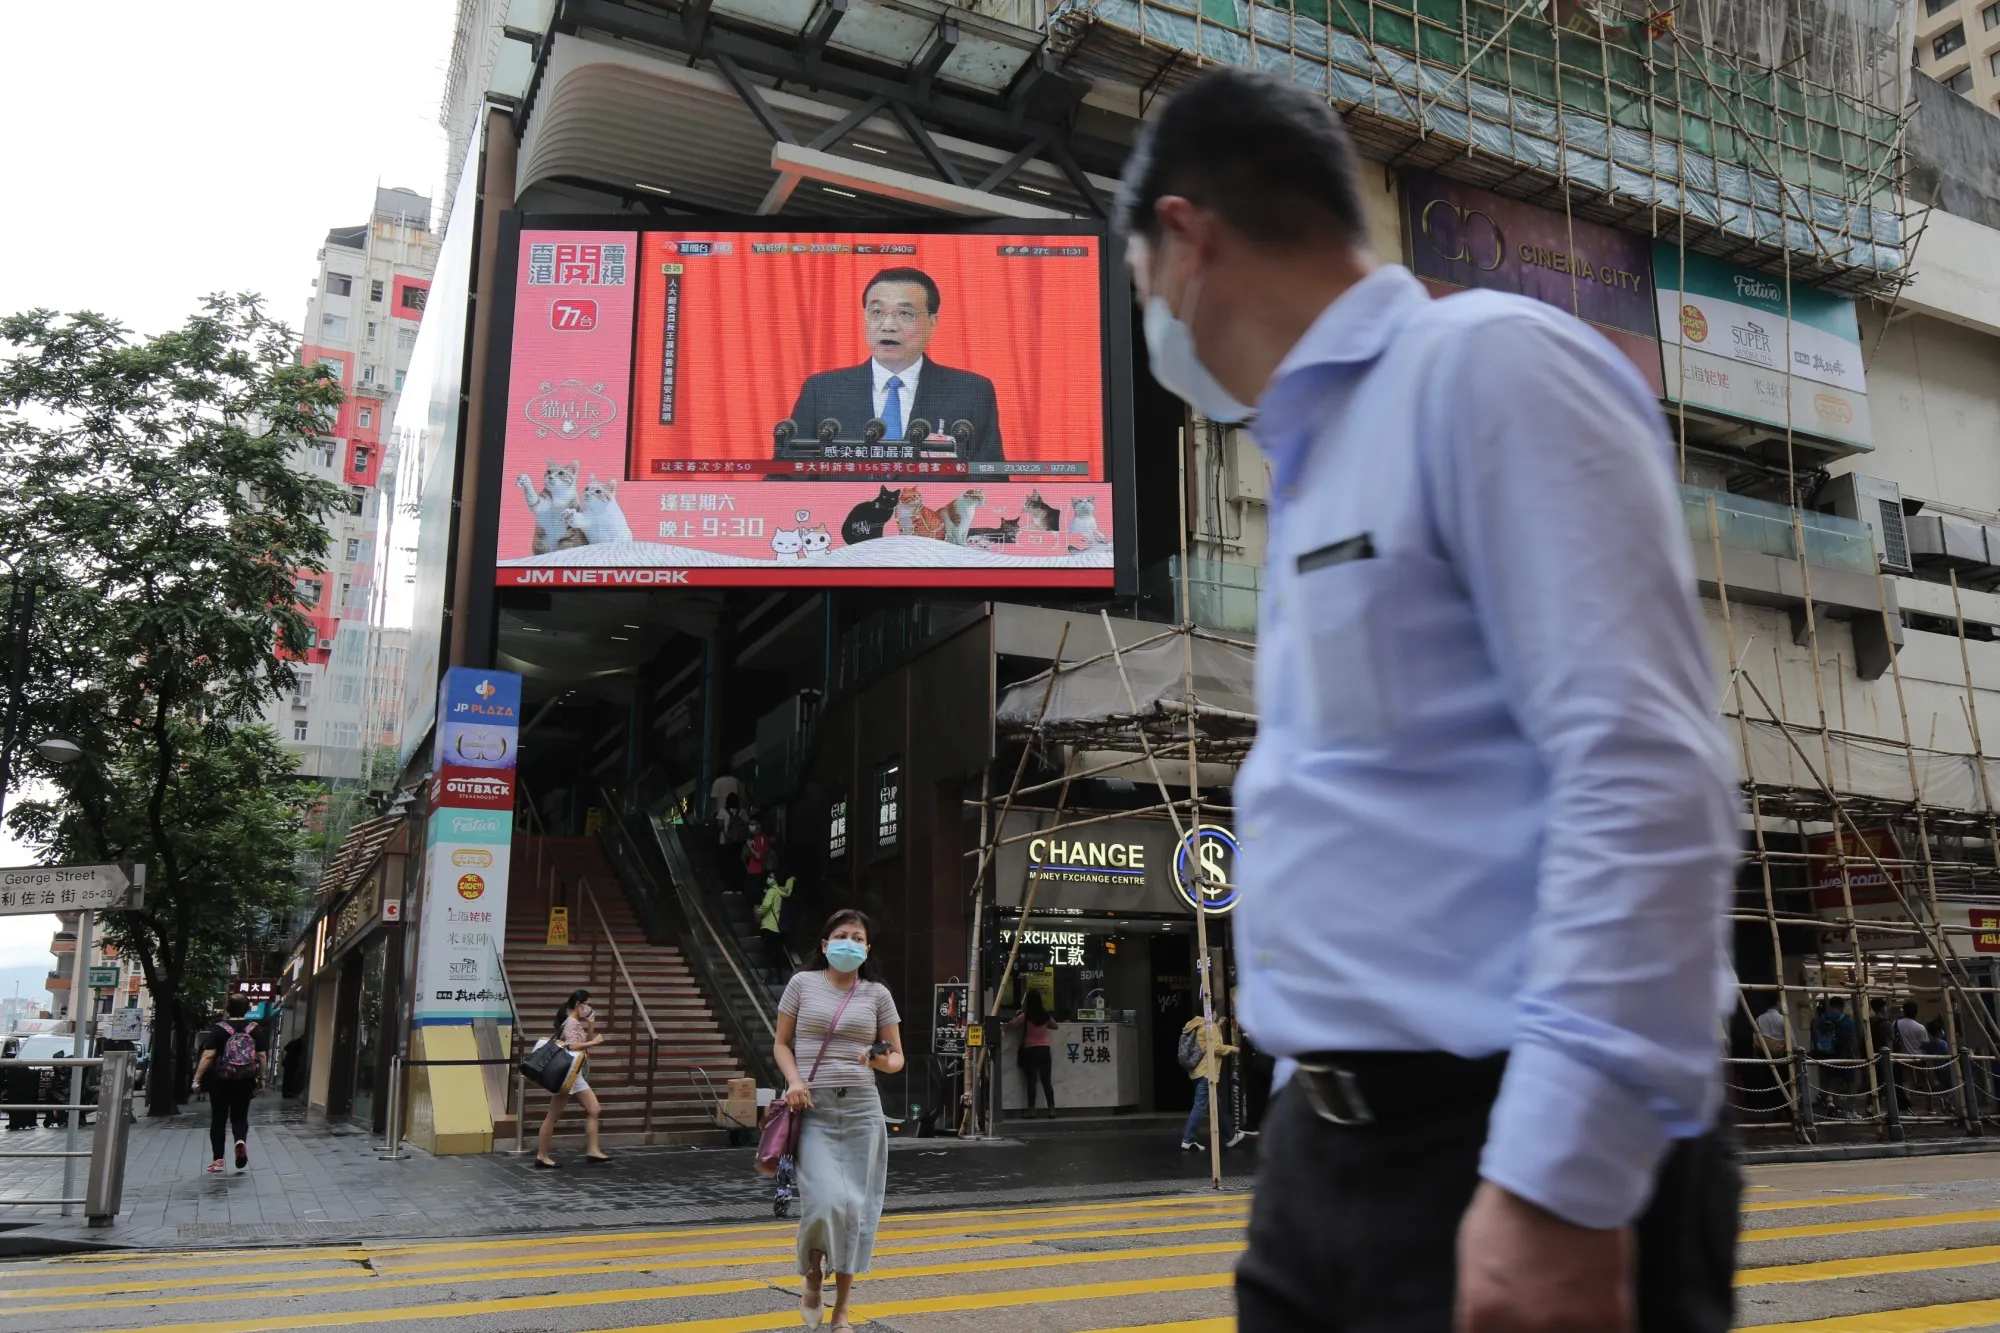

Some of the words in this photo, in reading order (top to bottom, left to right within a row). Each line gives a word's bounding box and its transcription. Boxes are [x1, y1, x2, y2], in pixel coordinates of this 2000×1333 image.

[1518, 243, 1596, 281] CINEMA
[1600, 264, 1642, 293] CITY
[1733, 275, 1781, 302] Festiva
[1731, 328, 1771, 353] SUPER
[824, 446, 914, 458] 感染範圍最廣
[660, 494, 736, 511] 逢星期六
[659, 520, 697, 539] 晚上
[702, 517, 765, 538] 9:30
[516, 570, 554, 584] JM
[562, 570, 690, 584] NETWORK
[453, 702, 469, 713] JP
[471, 704, 514, 717] PLAZA
[446, 782, 510, 796] OUTBACK
[452, 816, 500, 834] Festiva
[1029, 839, 1145, 868] CHANGE
[5, 873, 51, 886] George
[55, 869, 96, 882] Street
[1062, 874, 1110, 883] EXCHANGE
[1112, 877, 1146, 885] CENTRE
[2, 889, 76, 906] 利佐治街
[82, 889, 113, 900] 25-29
[447, 907, 492, 922] 上海姥姥
[1049, 946, 1084, 967] 汇款
[450, 964, 478, 973] SUPER
[1082, 1026, 1110, 1043] 民币
[1082, 1046, 1111, 1063] 兑换
